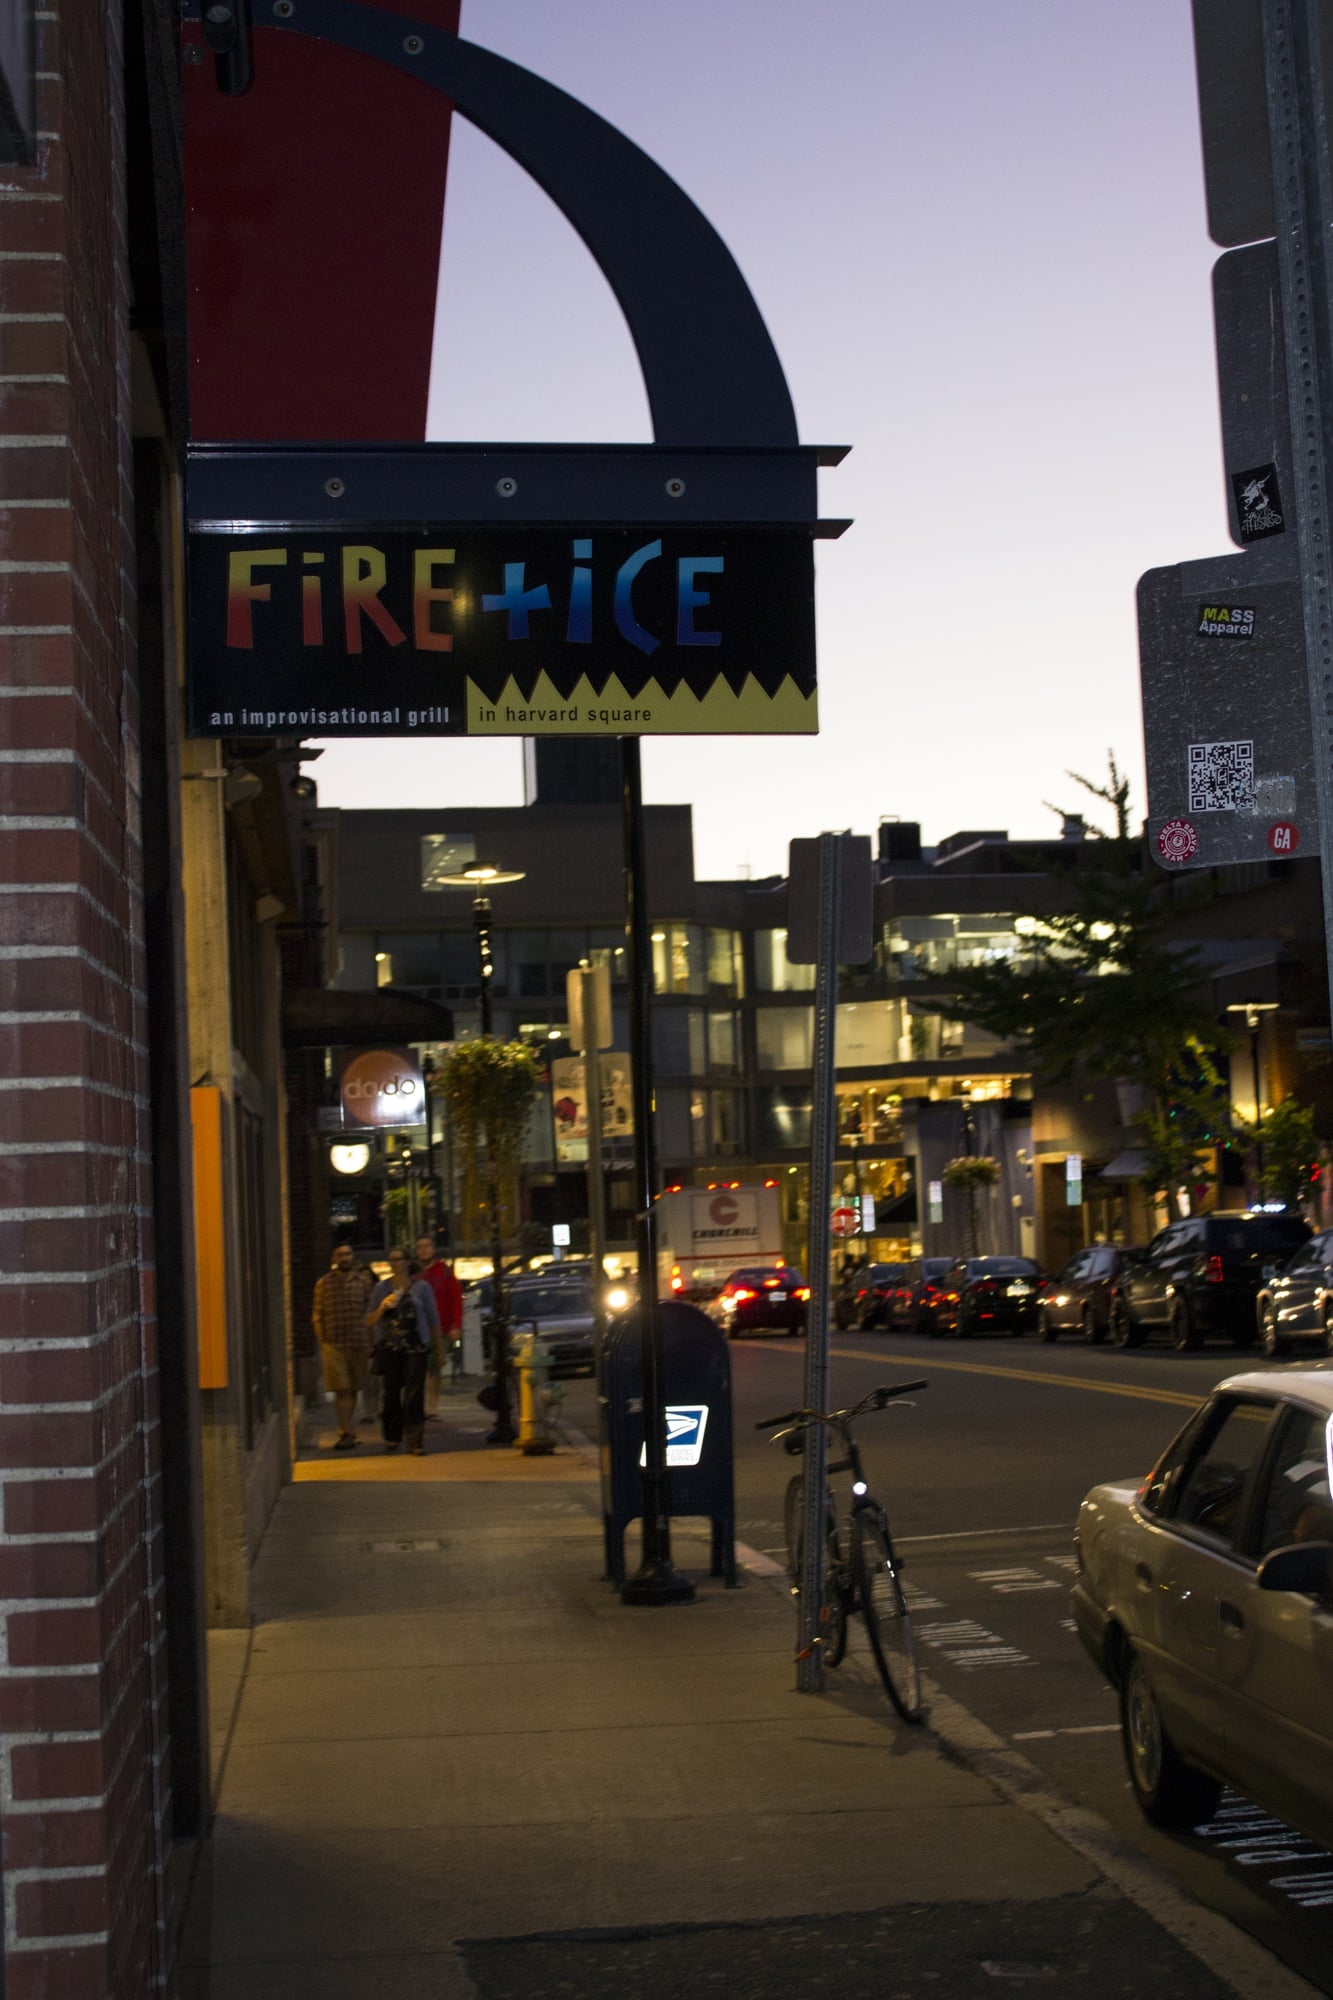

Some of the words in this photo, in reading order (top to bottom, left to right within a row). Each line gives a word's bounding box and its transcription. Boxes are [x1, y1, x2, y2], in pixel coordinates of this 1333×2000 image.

[1203, 607, 1255, 623] MASS
[1199, 620, 1253, 636] Apparel
[211, 712, 234, 725] an
[242, 708, 400, 728] improvisational
[408, 707, 449, 727] grill
[479, 707, 496, 722] in
[506, 707, 578, 722] harvard
[588, 709, 652, 725] square
[1160, 821, 1182, 840] DELTA
[1184, 823, 1197, 852] BRAVO
[1274, 827, 1291, 849] GA
[1162, 848, 1184, 862] TEAM
